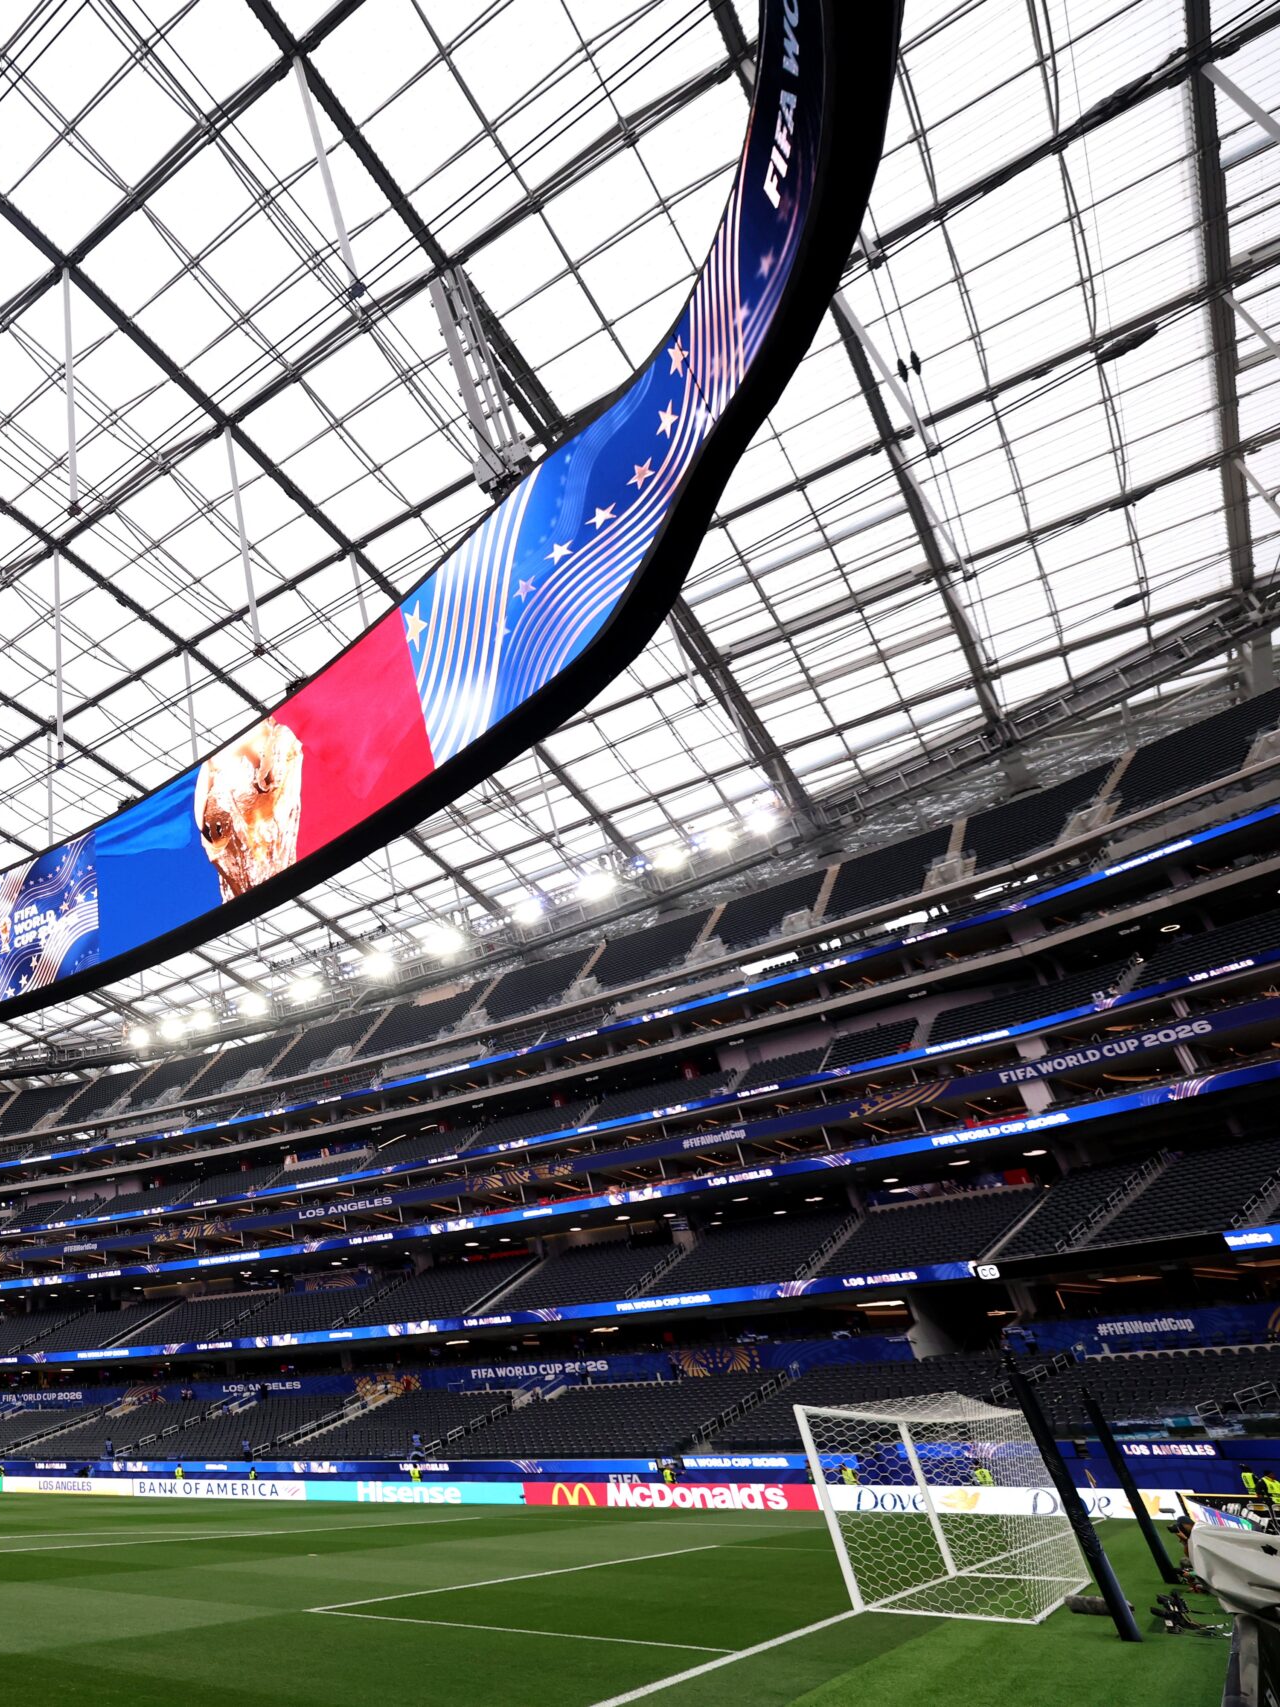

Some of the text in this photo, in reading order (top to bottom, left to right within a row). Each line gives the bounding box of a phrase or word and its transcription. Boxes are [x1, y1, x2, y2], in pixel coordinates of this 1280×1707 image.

[763, 90, 797, 209] FIFA
[14, 904, 38, 923] FIFA
[14, 910, 57, 936] WORLD
[14, 930, 37, 948] CUP
[999, 1020, 1212, 1083] FIFA WORLD CUP 2026
[682, 1128, 746, 1150] #FIFAWorldCup
[931, 1112, 1070, 1148] FIFA WORLD CUP 2026
[708, 1168, 773, 1186] LOS ANGELES
[299, 1196, 392, 1220] LOS ANGELES
[349, 1232, 393, 1244] LOS ANGELES
[843, 1270, 918, 1286] LOS ANGELES
[981, 1267, 997, 1277] CC
[463, 1316, 511, 1326] LOS ANGELES
[1097, 1318, 1194, 1336] #FIFAWorldCup
[471, 1367, 495, 1380] FIFA
[495, 1364, 537, 1378] WORLD
[538, 1362, 563, 1375] CUP
[223, 1383, 246, 1392] LOS
[2, 1394, 17, 1402] FIFA
[42, 1392, 56, 1401] CUP
[57, 1392, 82, 1400] 2026
[1123, 1444, 1216, 1456] LOS ANGELES
[698, 1458, 789, 1468] WORLD CUP 2026
[38, 1481, 92, 1491] LOS ANGELES
[608, 1474, 642, 1484] FIFA
[139, 1482, 279, 1496] BANK OF AMERICA
[357, 1481, 462, 1504] Hisense
[606, 1483, 789, 1511] McDonald's
[856, 1485, 927, 1511] Dove
[1026, 1487, 1113, 1518] Dve
